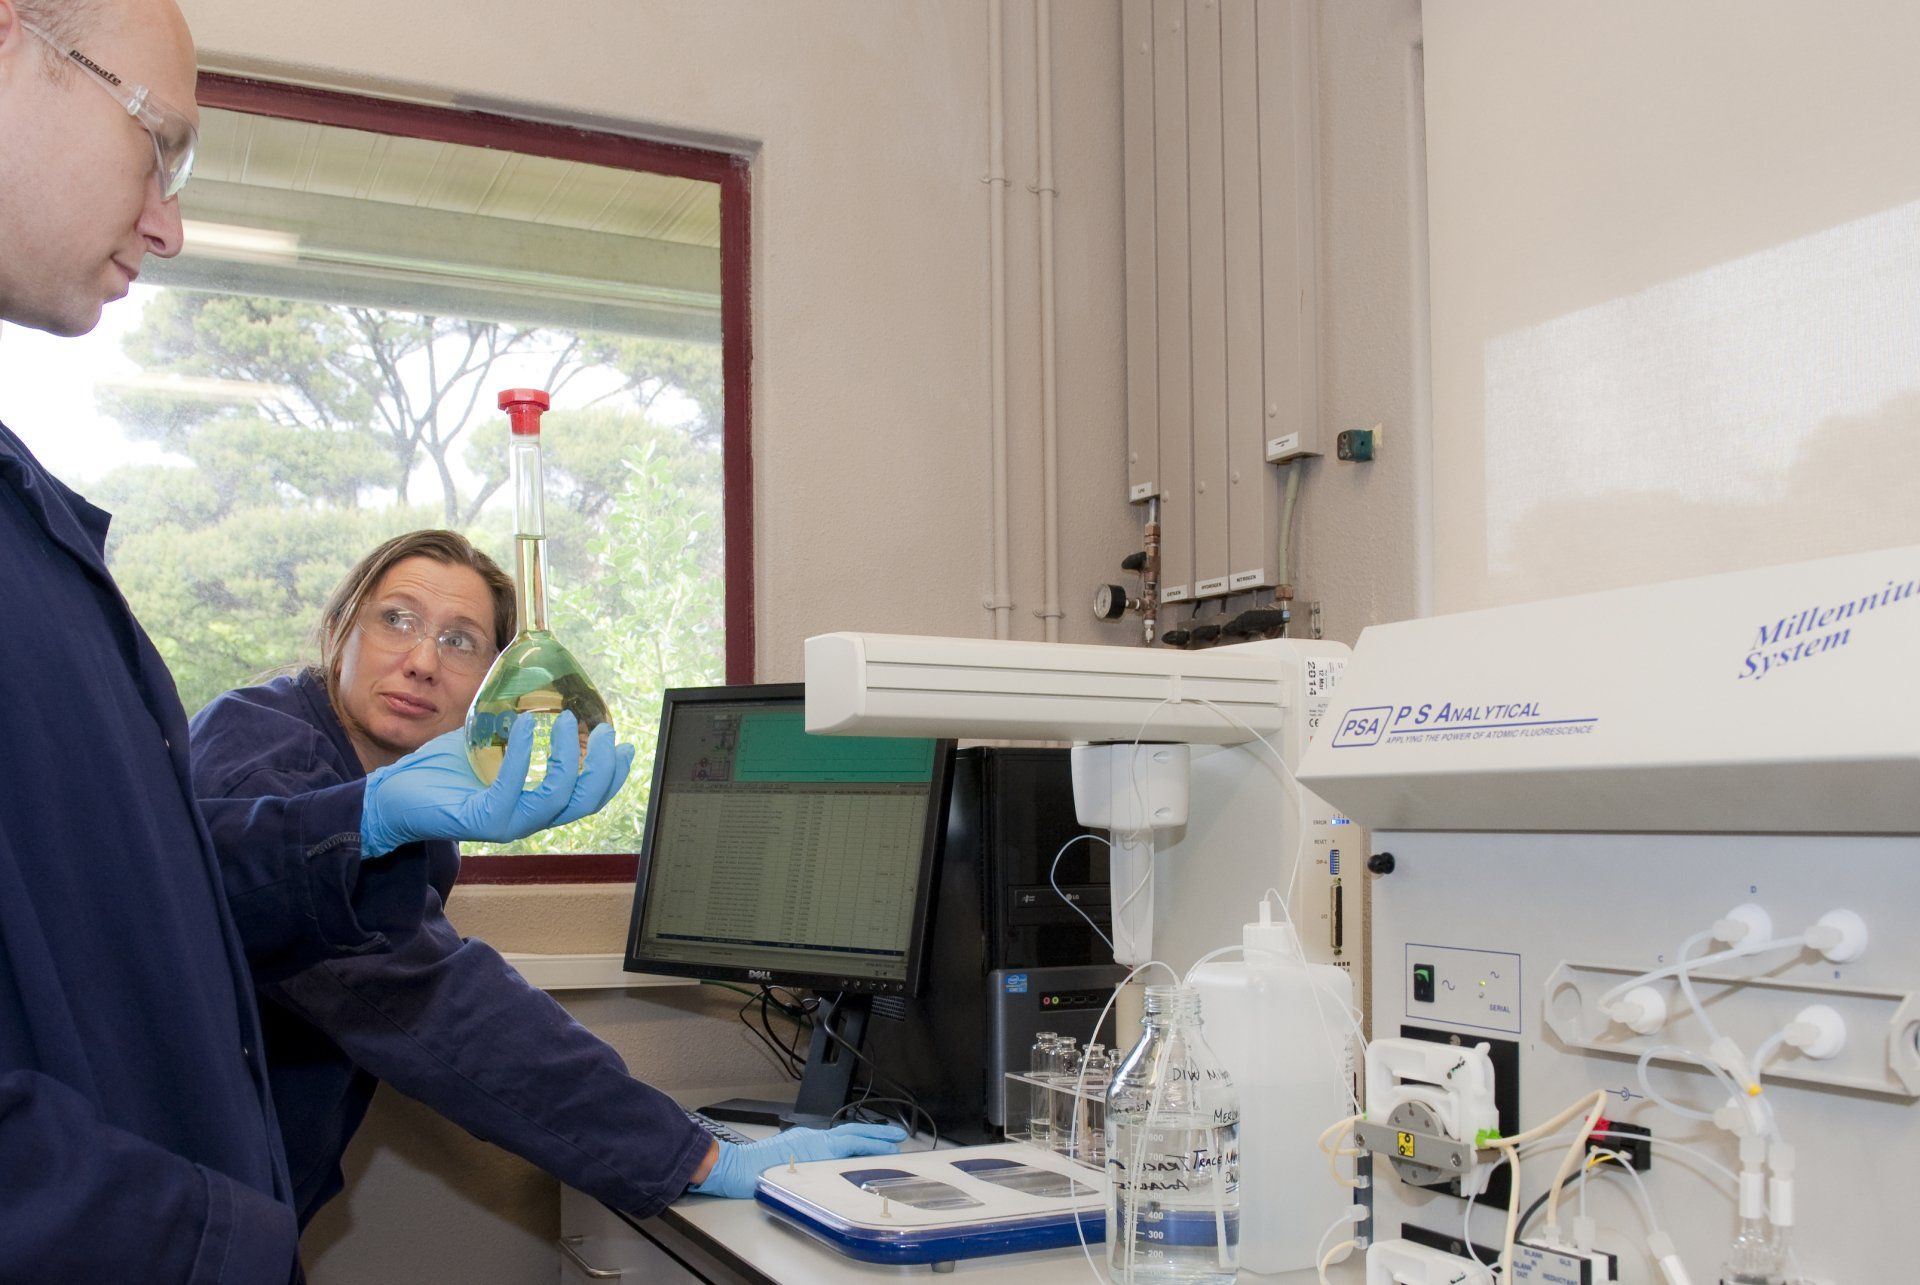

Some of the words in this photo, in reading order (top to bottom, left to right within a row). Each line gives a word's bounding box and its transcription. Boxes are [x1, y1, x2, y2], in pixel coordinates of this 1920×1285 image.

[69, 50, 121, 86] prosafe
[1236, 574, 1257, 583] NITROGEN
[1751, 579, 1920, 651] Millenniu
[1738, 628, 1851, 680] System
[1307, 661, 1317, 696] 2014
[1342, 717, 1379, 737] PSA
[1385, 735, 1423, 744] APPLYING
[1424, 733, 1440, 743] THE
[1441, 732, 1471, 742] POWER
[1472, 731, 1485, 740] OF
[1485, 730, 1519, 739] ATOMIC
[1519, 725, 1594, 737] FLUORESCENCE
[1750, 885, 1758, 894] D
[749, 969, 772, 981] DELL
[1489, 1003, 1511, 1013] SERIAL
[1193, 1149, 1222, 1170] TRACE
[1148, 1211, 1164, 1220] 400
[1148, 1231, 1164, 1239] 300
[1148, 1250, 1164, 1259] 200
[1523, 1249, 1543, 1259] BLANK
[1513, 1260, 1532, 1271] BLANK
[1516, 1270, 1528, 1279] OUT
